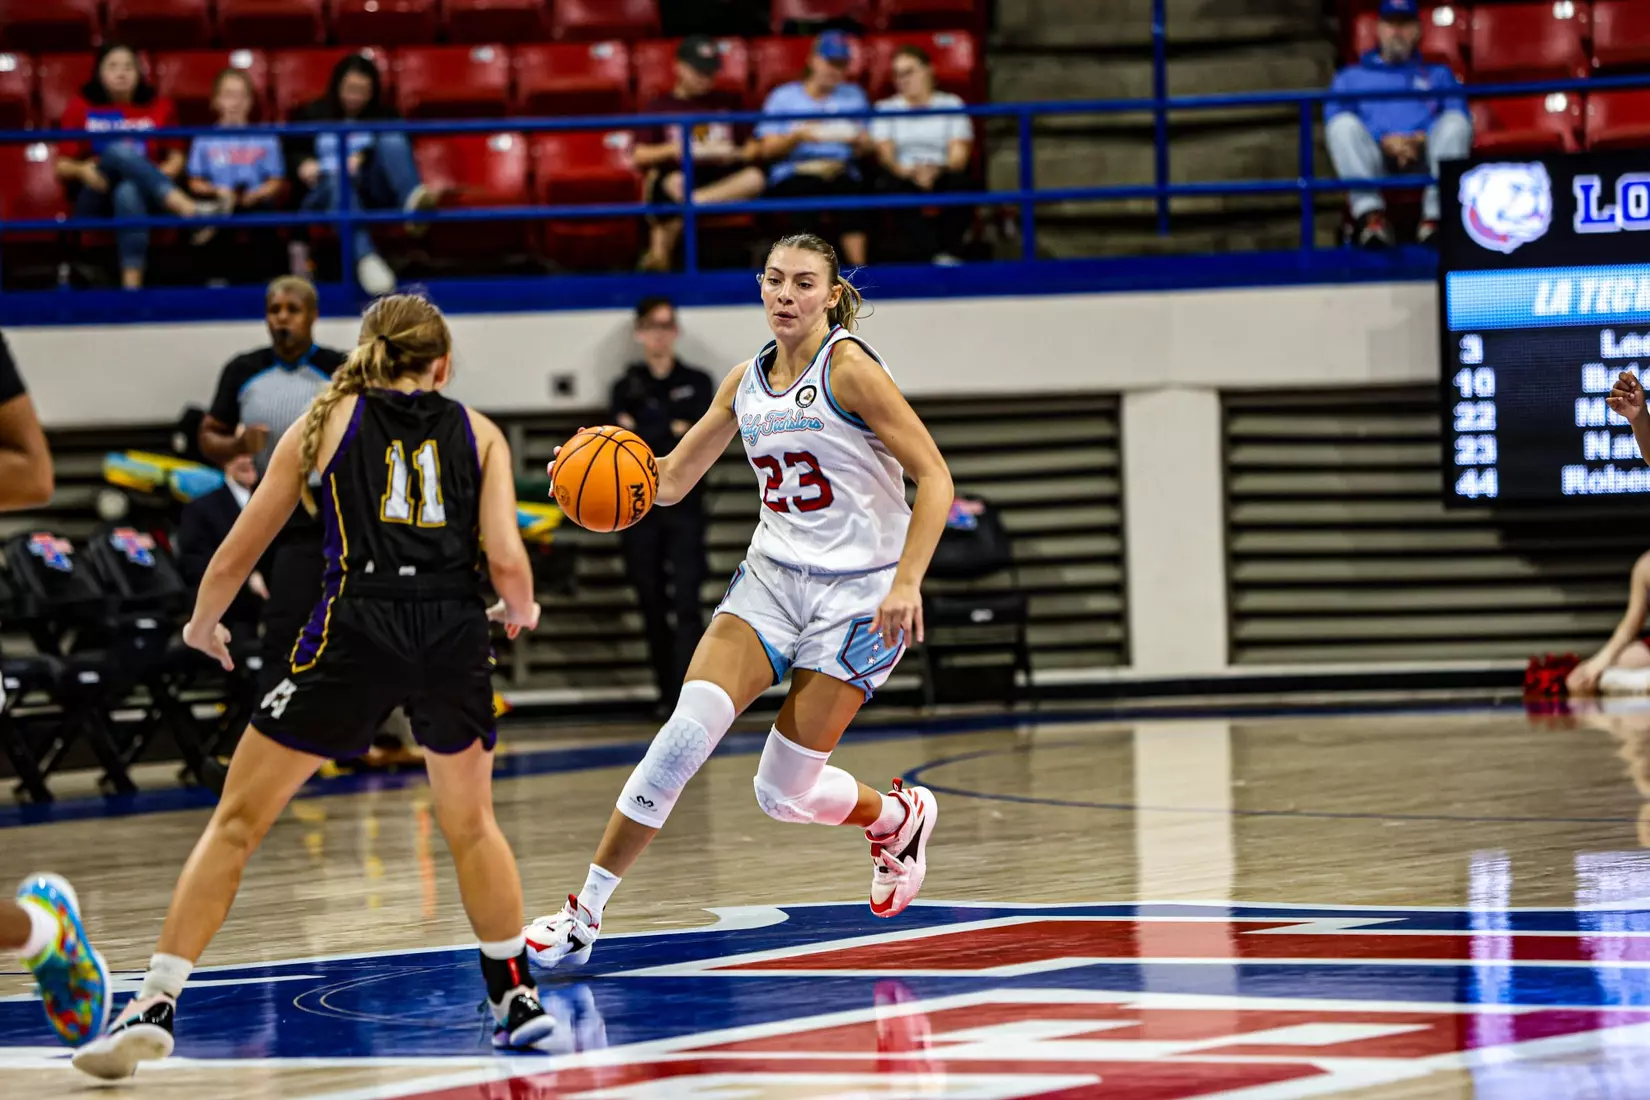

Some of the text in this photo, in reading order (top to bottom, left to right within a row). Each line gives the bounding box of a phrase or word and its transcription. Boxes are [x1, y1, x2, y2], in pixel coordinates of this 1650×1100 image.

[1534, 278, 1573, 316] LA
[1459, 334, 1483, 364] 3
[1454, 367, 1496, 397] 10
[760, 408, 824, 436] Techsters
[1455, 434, 1498, 465] 23
[380, 440, 446, 527] 11
[752, 451, 834, 512] 23
[1455, 467, 1498, 498] 44
